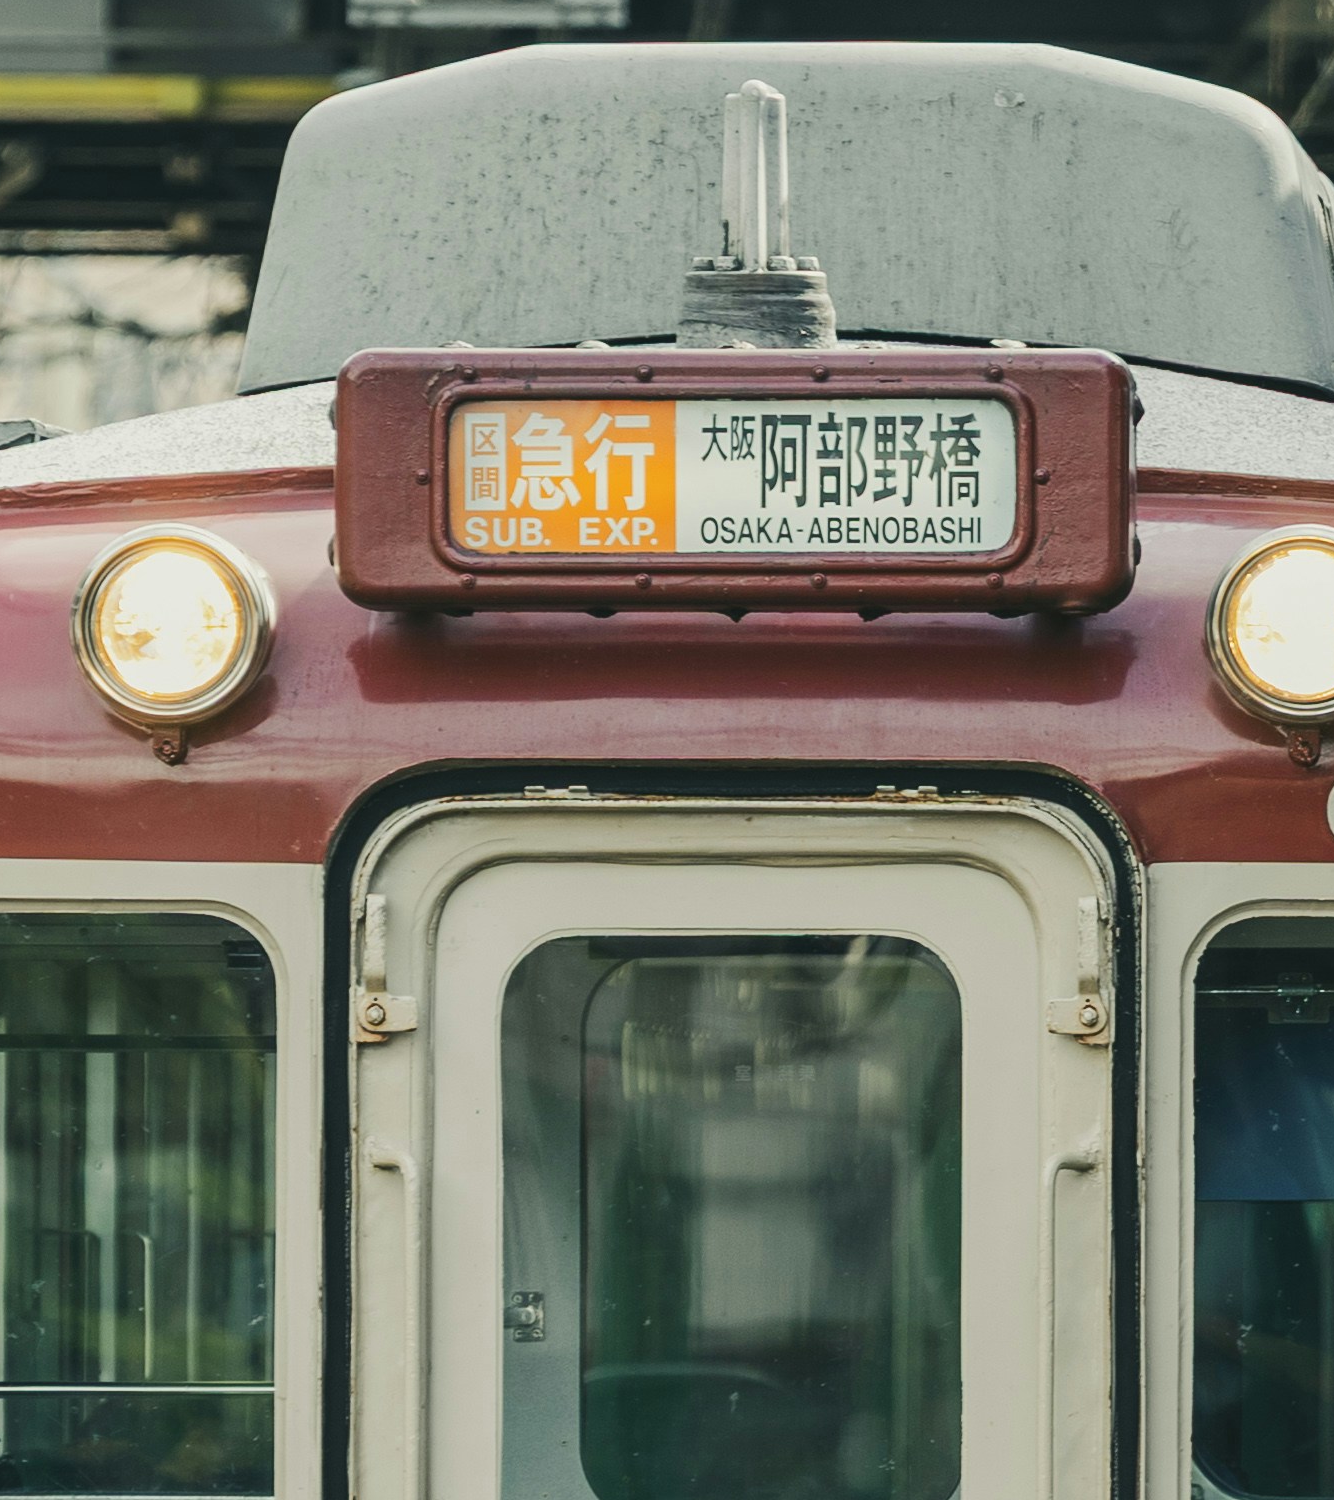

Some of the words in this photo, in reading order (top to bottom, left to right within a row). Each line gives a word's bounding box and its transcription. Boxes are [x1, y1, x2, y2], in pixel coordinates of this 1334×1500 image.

[511, 412, 655, 511] 急行
[466, 517, 550, 546] SUB.
[579, 517, 658, 546] EXP.
[700, 515, 982, 545] OSAKA-ABENOBASHI
